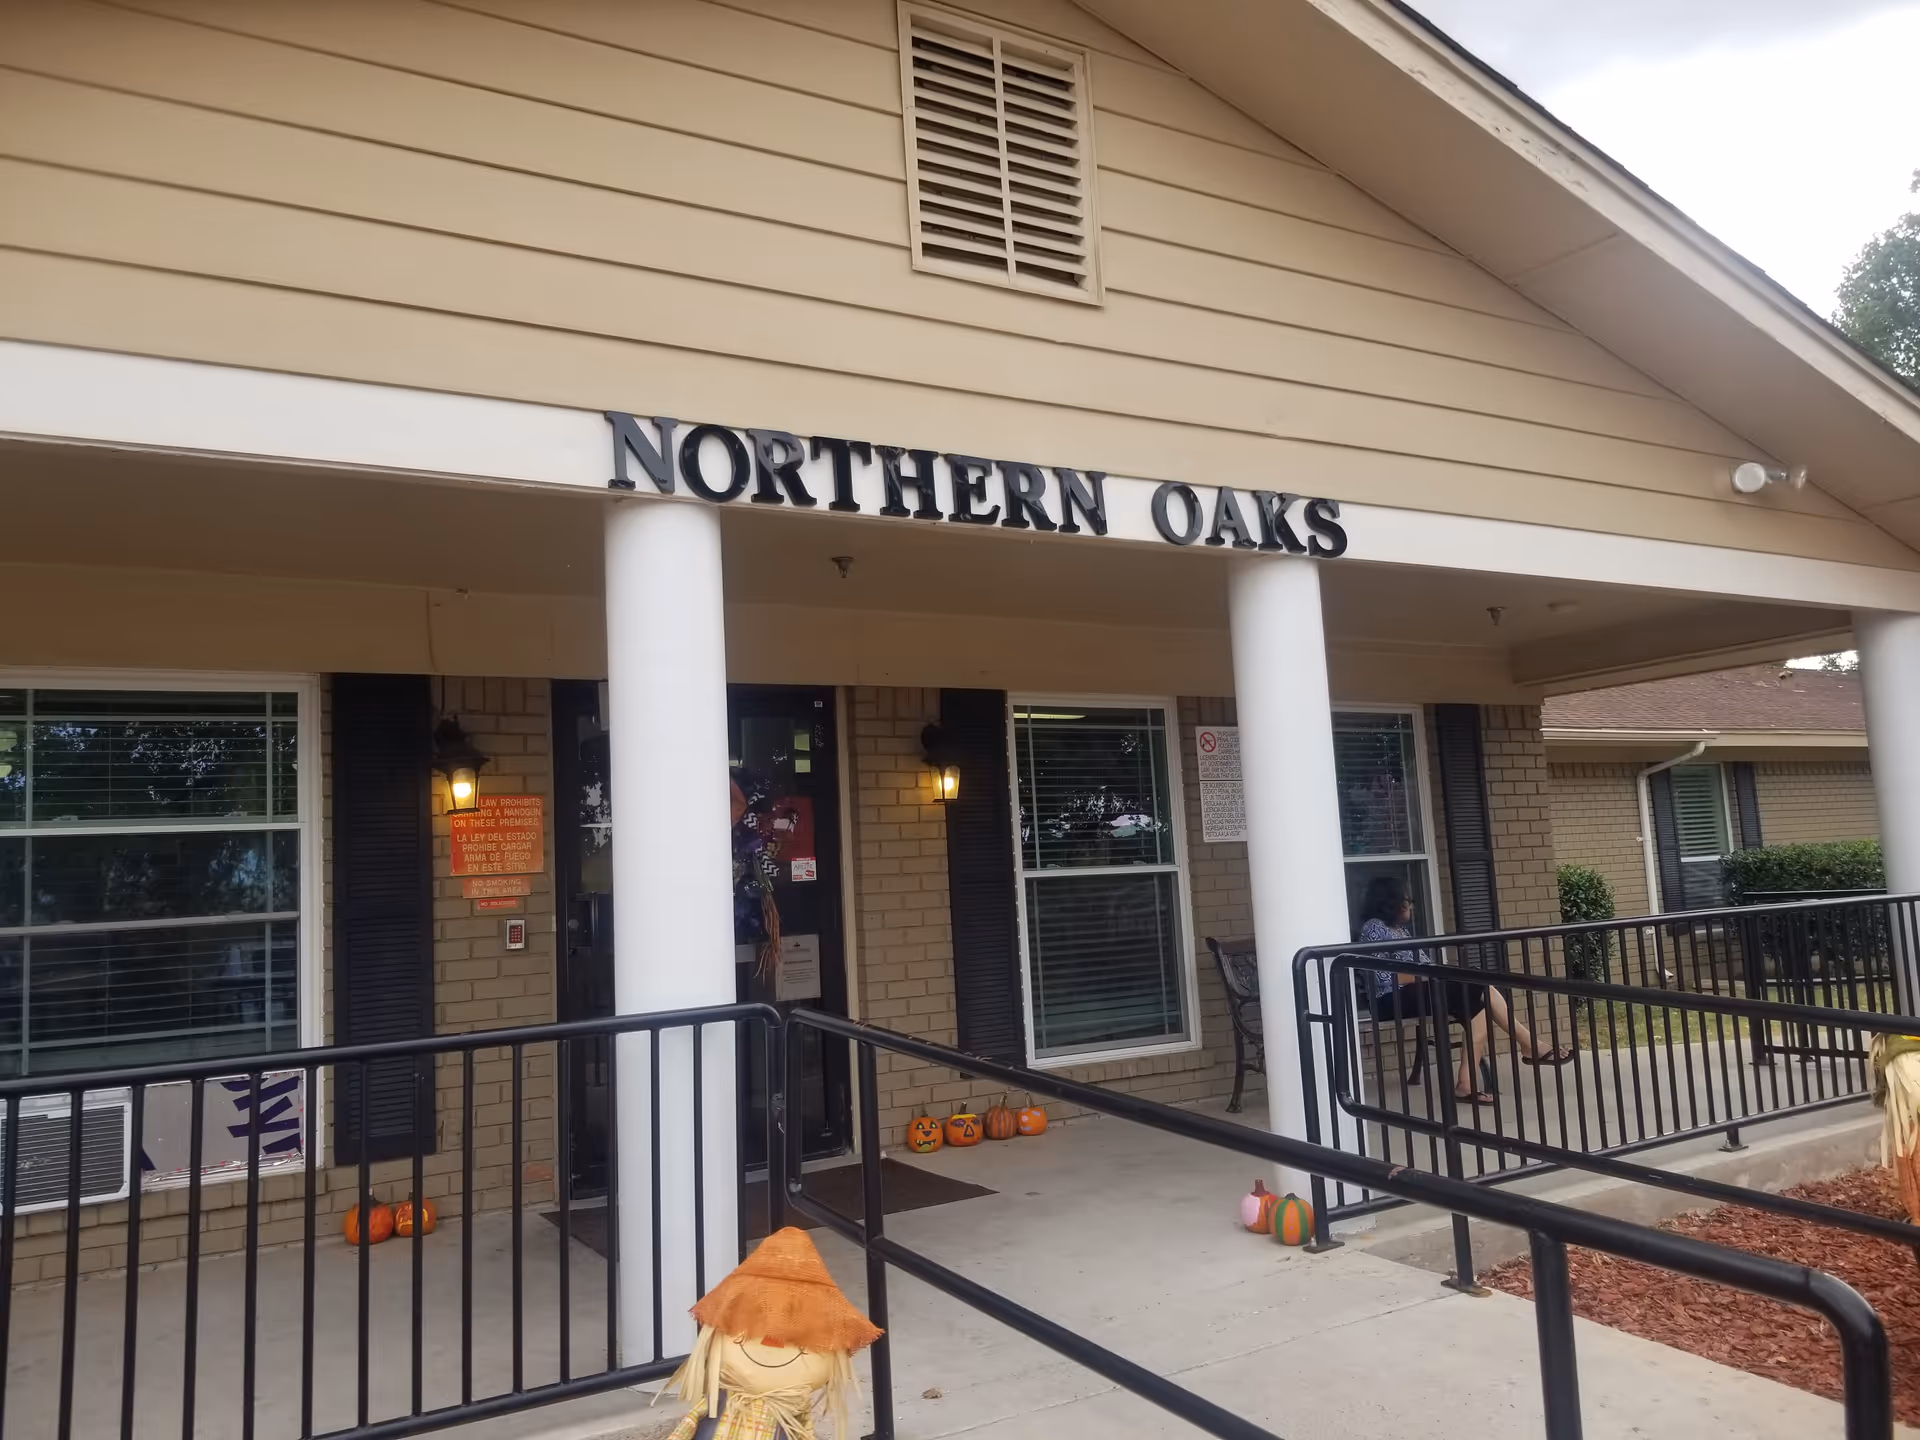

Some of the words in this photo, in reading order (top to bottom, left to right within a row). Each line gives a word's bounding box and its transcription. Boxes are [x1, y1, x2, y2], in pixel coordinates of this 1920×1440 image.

[605, 411, 1107, 535] NORTHERN
[1151, 480, 1348, 559] OAKS
[481, 799, 498, 807] LAW
[501, 798, 541, 806] PROHIBITS
[495, 809, 501, 817] A
[504, 808, 541, 816] HANDGUN
[454, 819, 466, 827] ON
[470, 819, 496, 827] THESE
[457, 834, 467, 842] LA
[470, 833, 486, 841] LEY
[488, 833, 503, 841] DEL
[506, 832, 537, 840] ESTADO
[462, 843, 497, 851] PROHIBE
[500, 842, 532, 850] CARGAR
[464, 853, 486, 862] ARMA
[490, 853, 500, 861] DE
[505, 852, 531, 860] FUEGO
[467, 864, 479, 872] EN
[482, 863, 503, 872] ESTE
[486, 879, 522, 887] SMOKING
[483, 887, 499, 895] THIS
[502, 886, 522, 894] AREA
